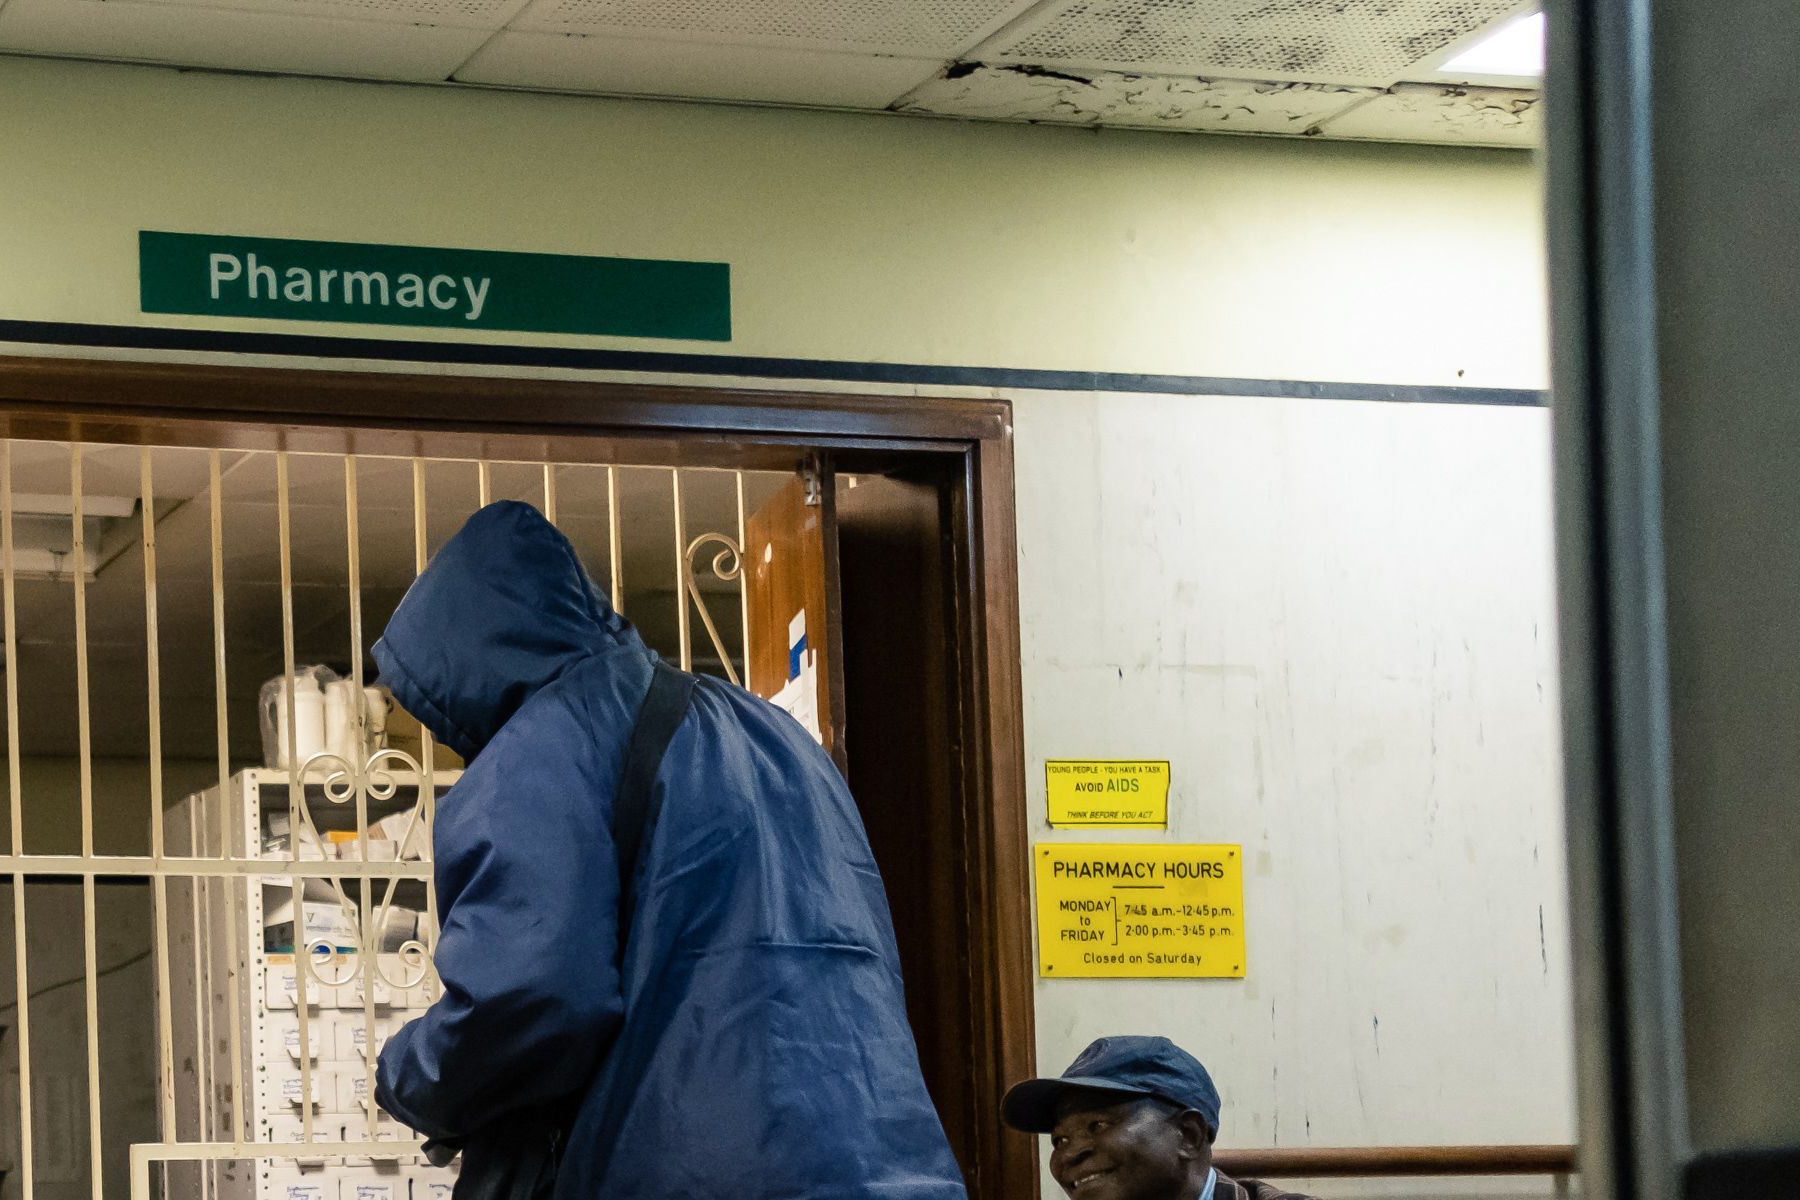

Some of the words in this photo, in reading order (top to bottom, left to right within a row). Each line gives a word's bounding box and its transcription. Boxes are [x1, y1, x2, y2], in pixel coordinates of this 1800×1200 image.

[209, 253, 491, 320] Pharmacy
[1075, 782, 1104, 792] AVOID
[1106, 778, 1140, 792] AIDS
[1067, 811, 1088, 819] THINK
[1089, 811, 1120, 819] BEFORE
[1053, 861, 1156, 878] PHARMACY
[1164, 862, 1224, 878] HOURS
[1059, 900, 1111, 912] MONDAY
[1079, 915, 1091, 926] to
[1060, 930, 1105, 942] FRIDAY
[1083, 952, 1125, 964] Closed
[1129, 954, 1143, 964] on
[1147, 952, 1202, 966] Saturday
